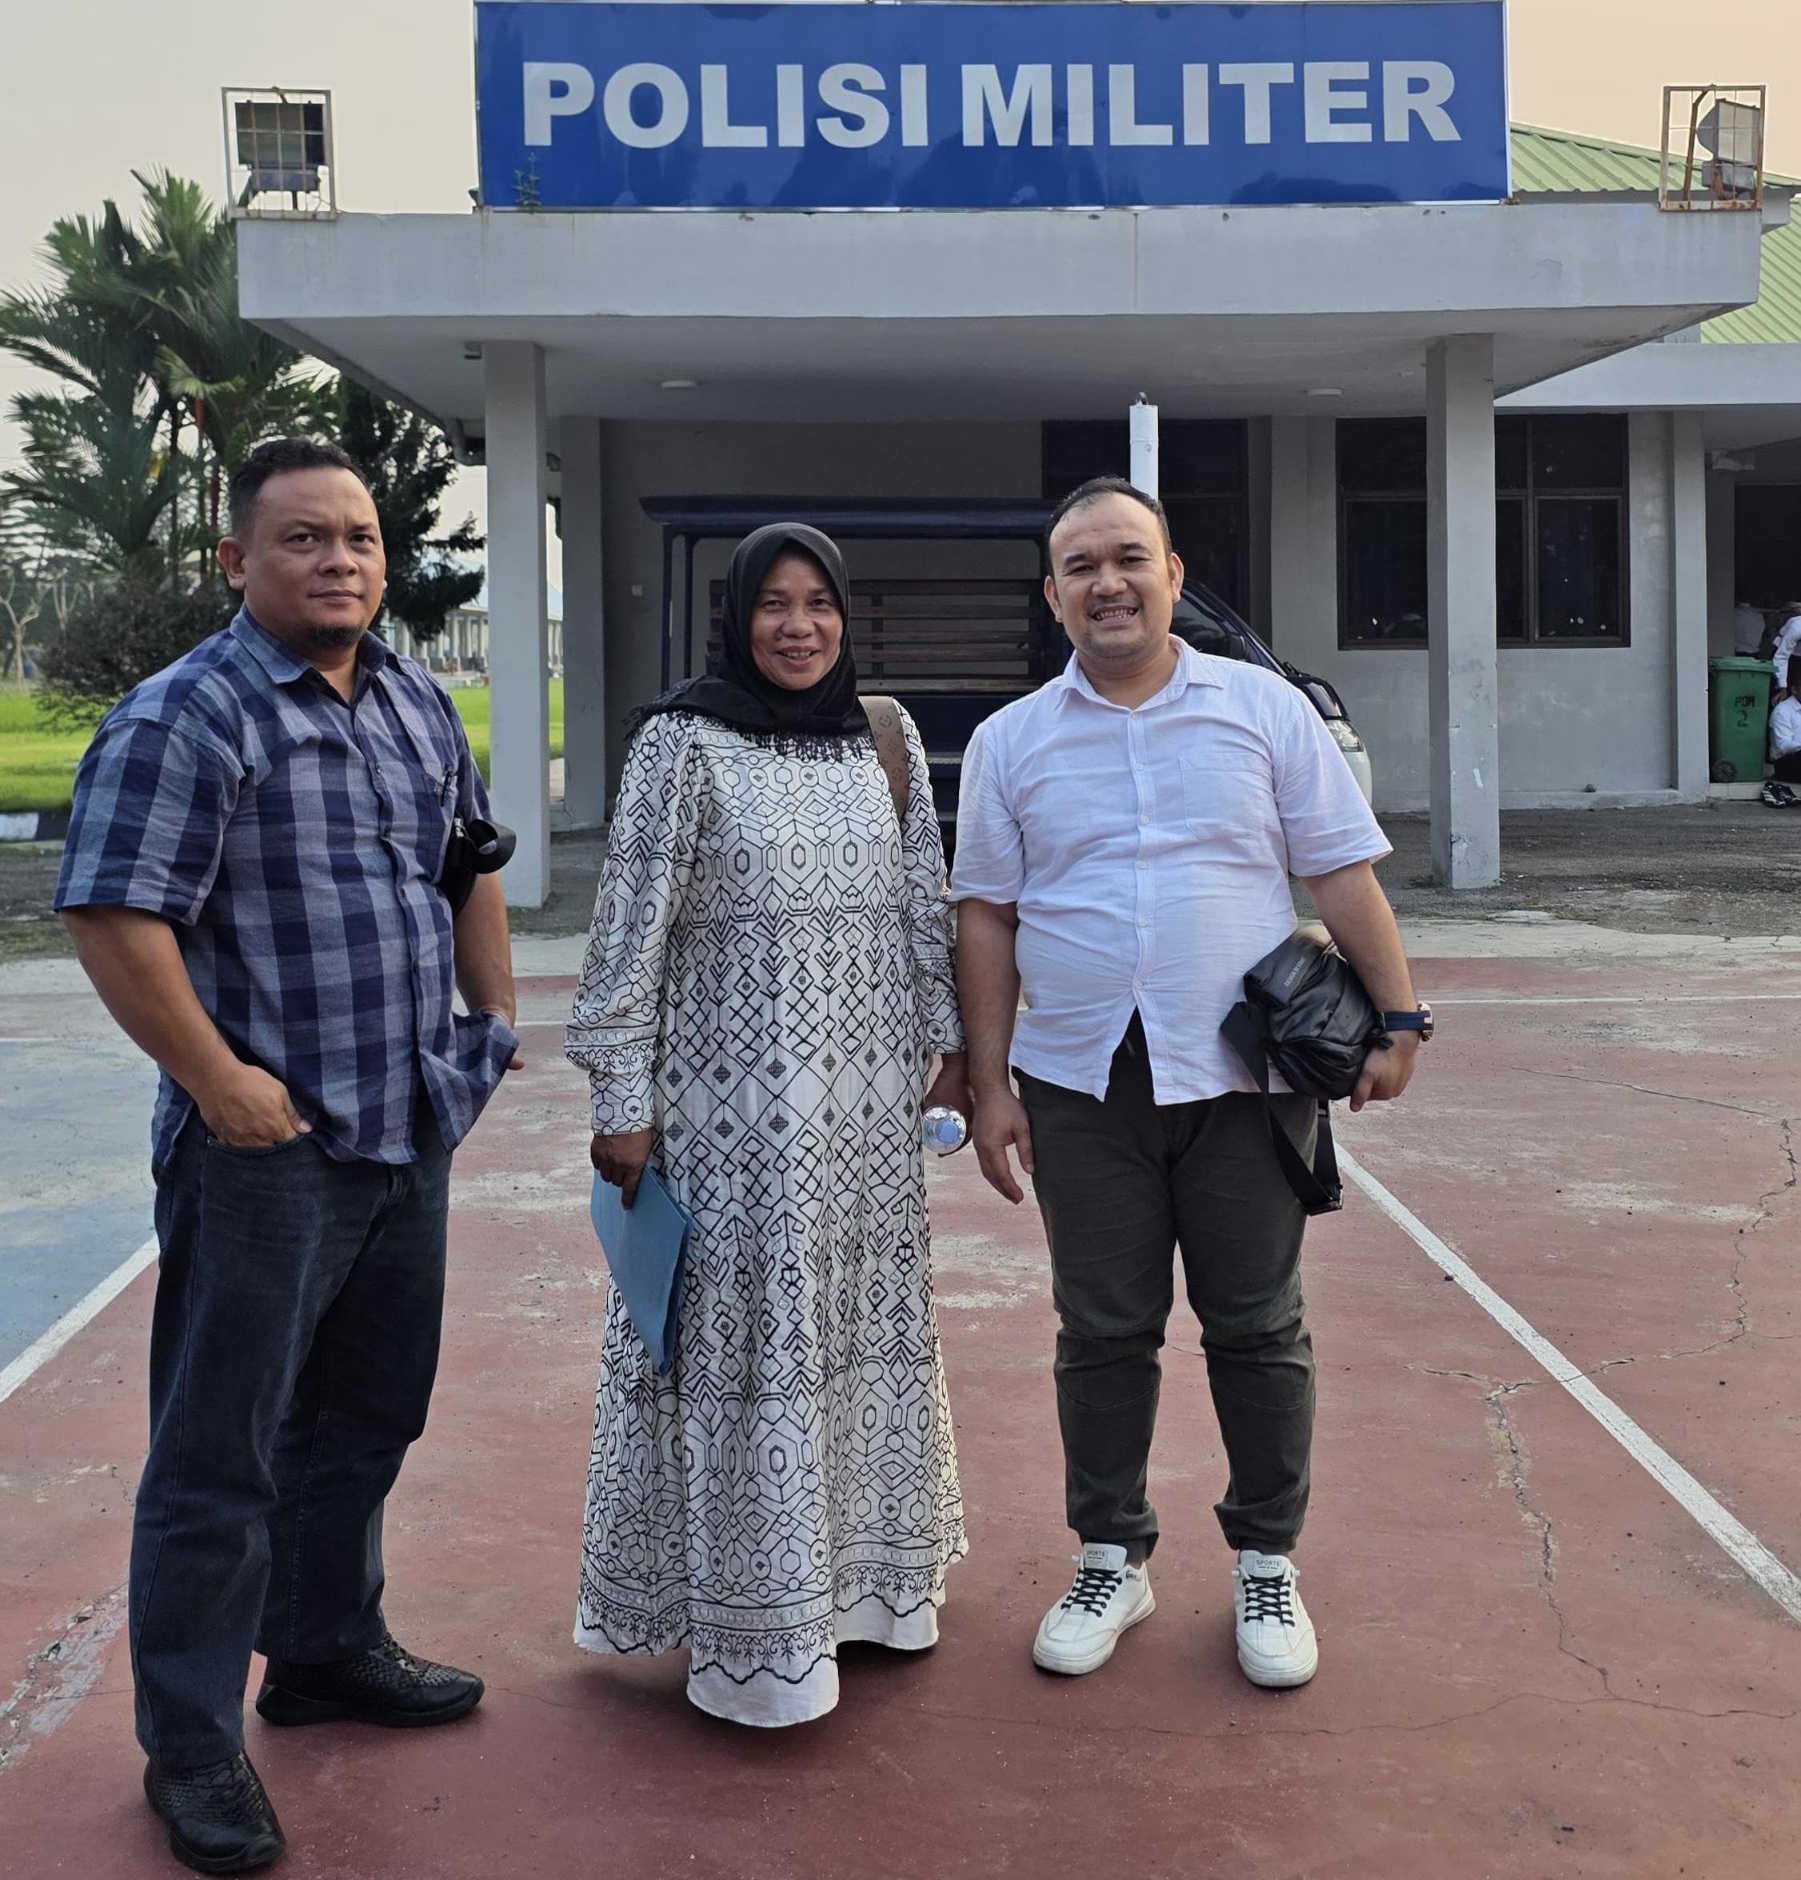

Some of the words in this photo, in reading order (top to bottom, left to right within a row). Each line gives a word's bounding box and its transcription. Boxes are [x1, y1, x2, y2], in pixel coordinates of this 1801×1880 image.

[523, 62, 928, 148] POLISI
[961, 60, 1461, 146] MILITER
[1736, 709, 1748, 728] 2
[1256, 1559, 1280, 1567] SPORTS
